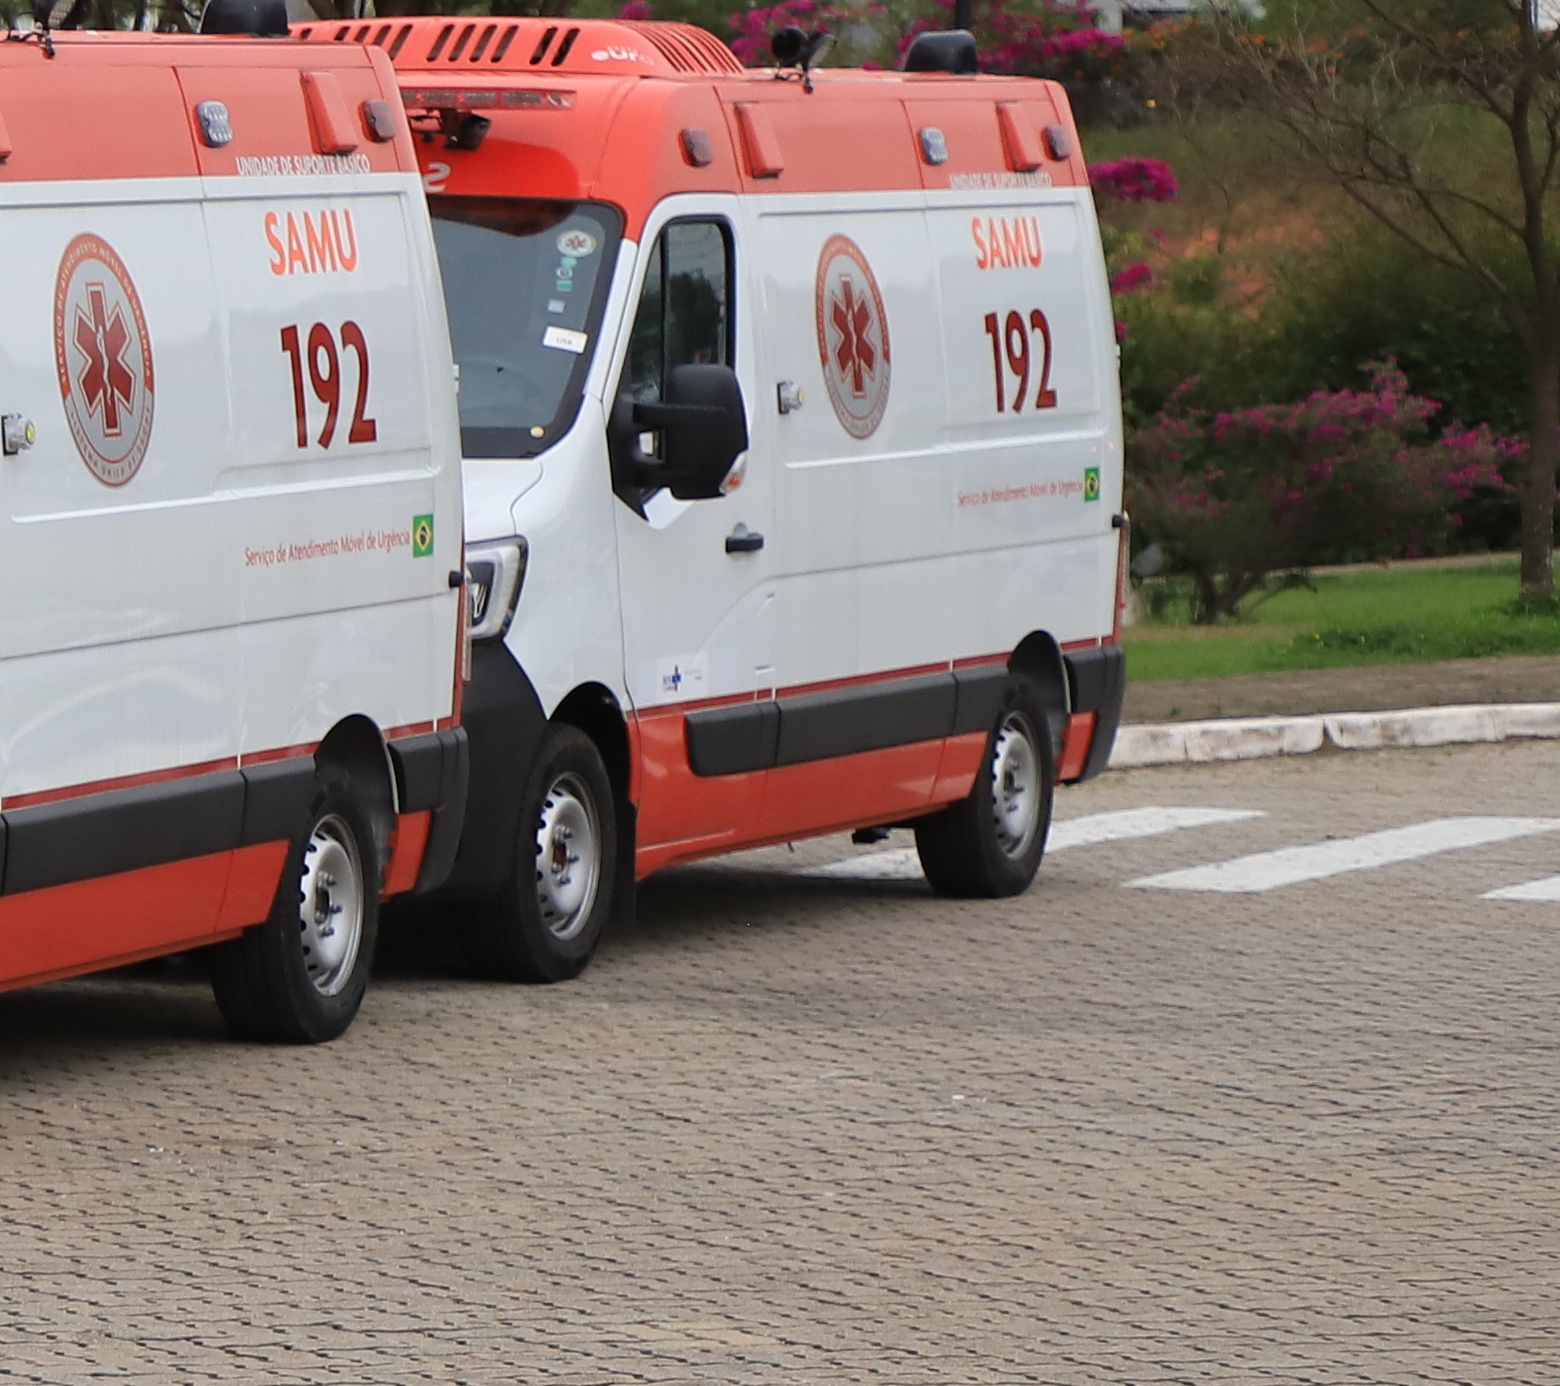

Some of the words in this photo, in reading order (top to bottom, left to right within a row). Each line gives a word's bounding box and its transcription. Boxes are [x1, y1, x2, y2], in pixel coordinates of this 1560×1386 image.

[279, 156, 293, 175] DE
[265, 209, 358, 276] SAMU
[972, 216, 1043, 269] SAMU
[280, 320, 377, 450] 192
[985, 309, 1058, 414] 192
[245, 546, 275, 568] Serviço
[277, 543, 287, 562] de
[288, 539, 339, 561] Atendimento
[366, 530, 377, 549] de
[377, 527, 410, 553] Urgência
